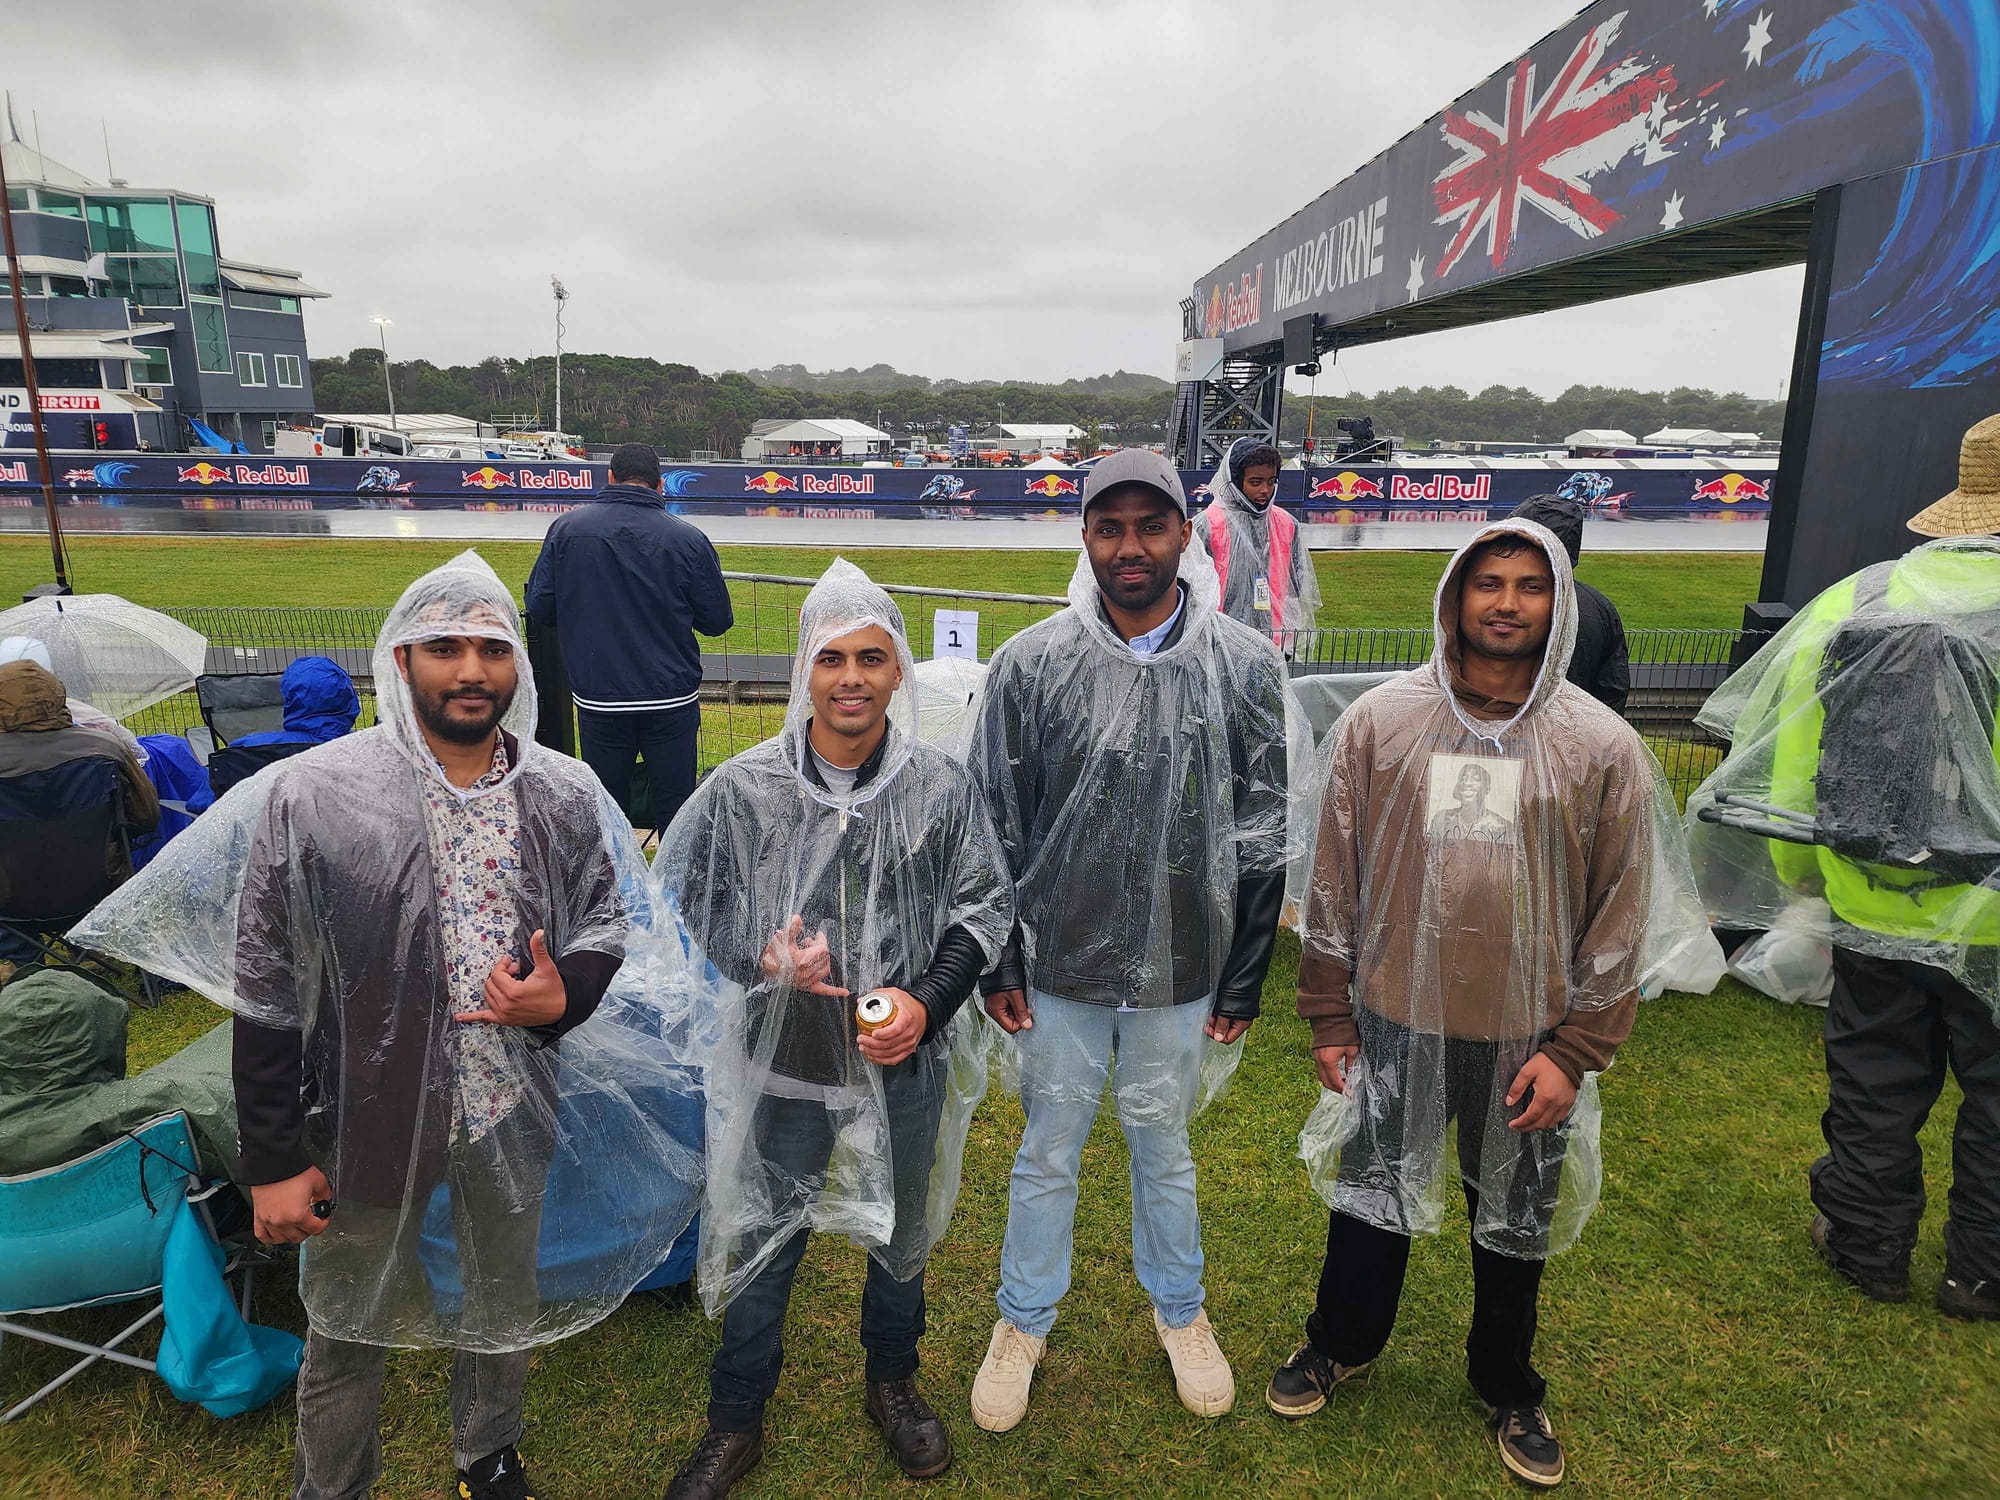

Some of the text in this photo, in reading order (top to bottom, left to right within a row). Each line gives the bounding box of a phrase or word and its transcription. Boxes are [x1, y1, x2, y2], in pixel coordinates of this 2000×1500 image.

[1273, 196, 1388, 312] MELBOURNE
[1226, 262, 1263, 333] Red Bull
[0, 423, 48, 433] ELBOURE
[236, 465, 310, 485] Red Bull
[520, 469, 592, 489] Red Bull
[803, 474, 874, 493] Red Bull
[1391, 474, 1491, 500] Red Bull
[948, 630, 962, 648] 1
